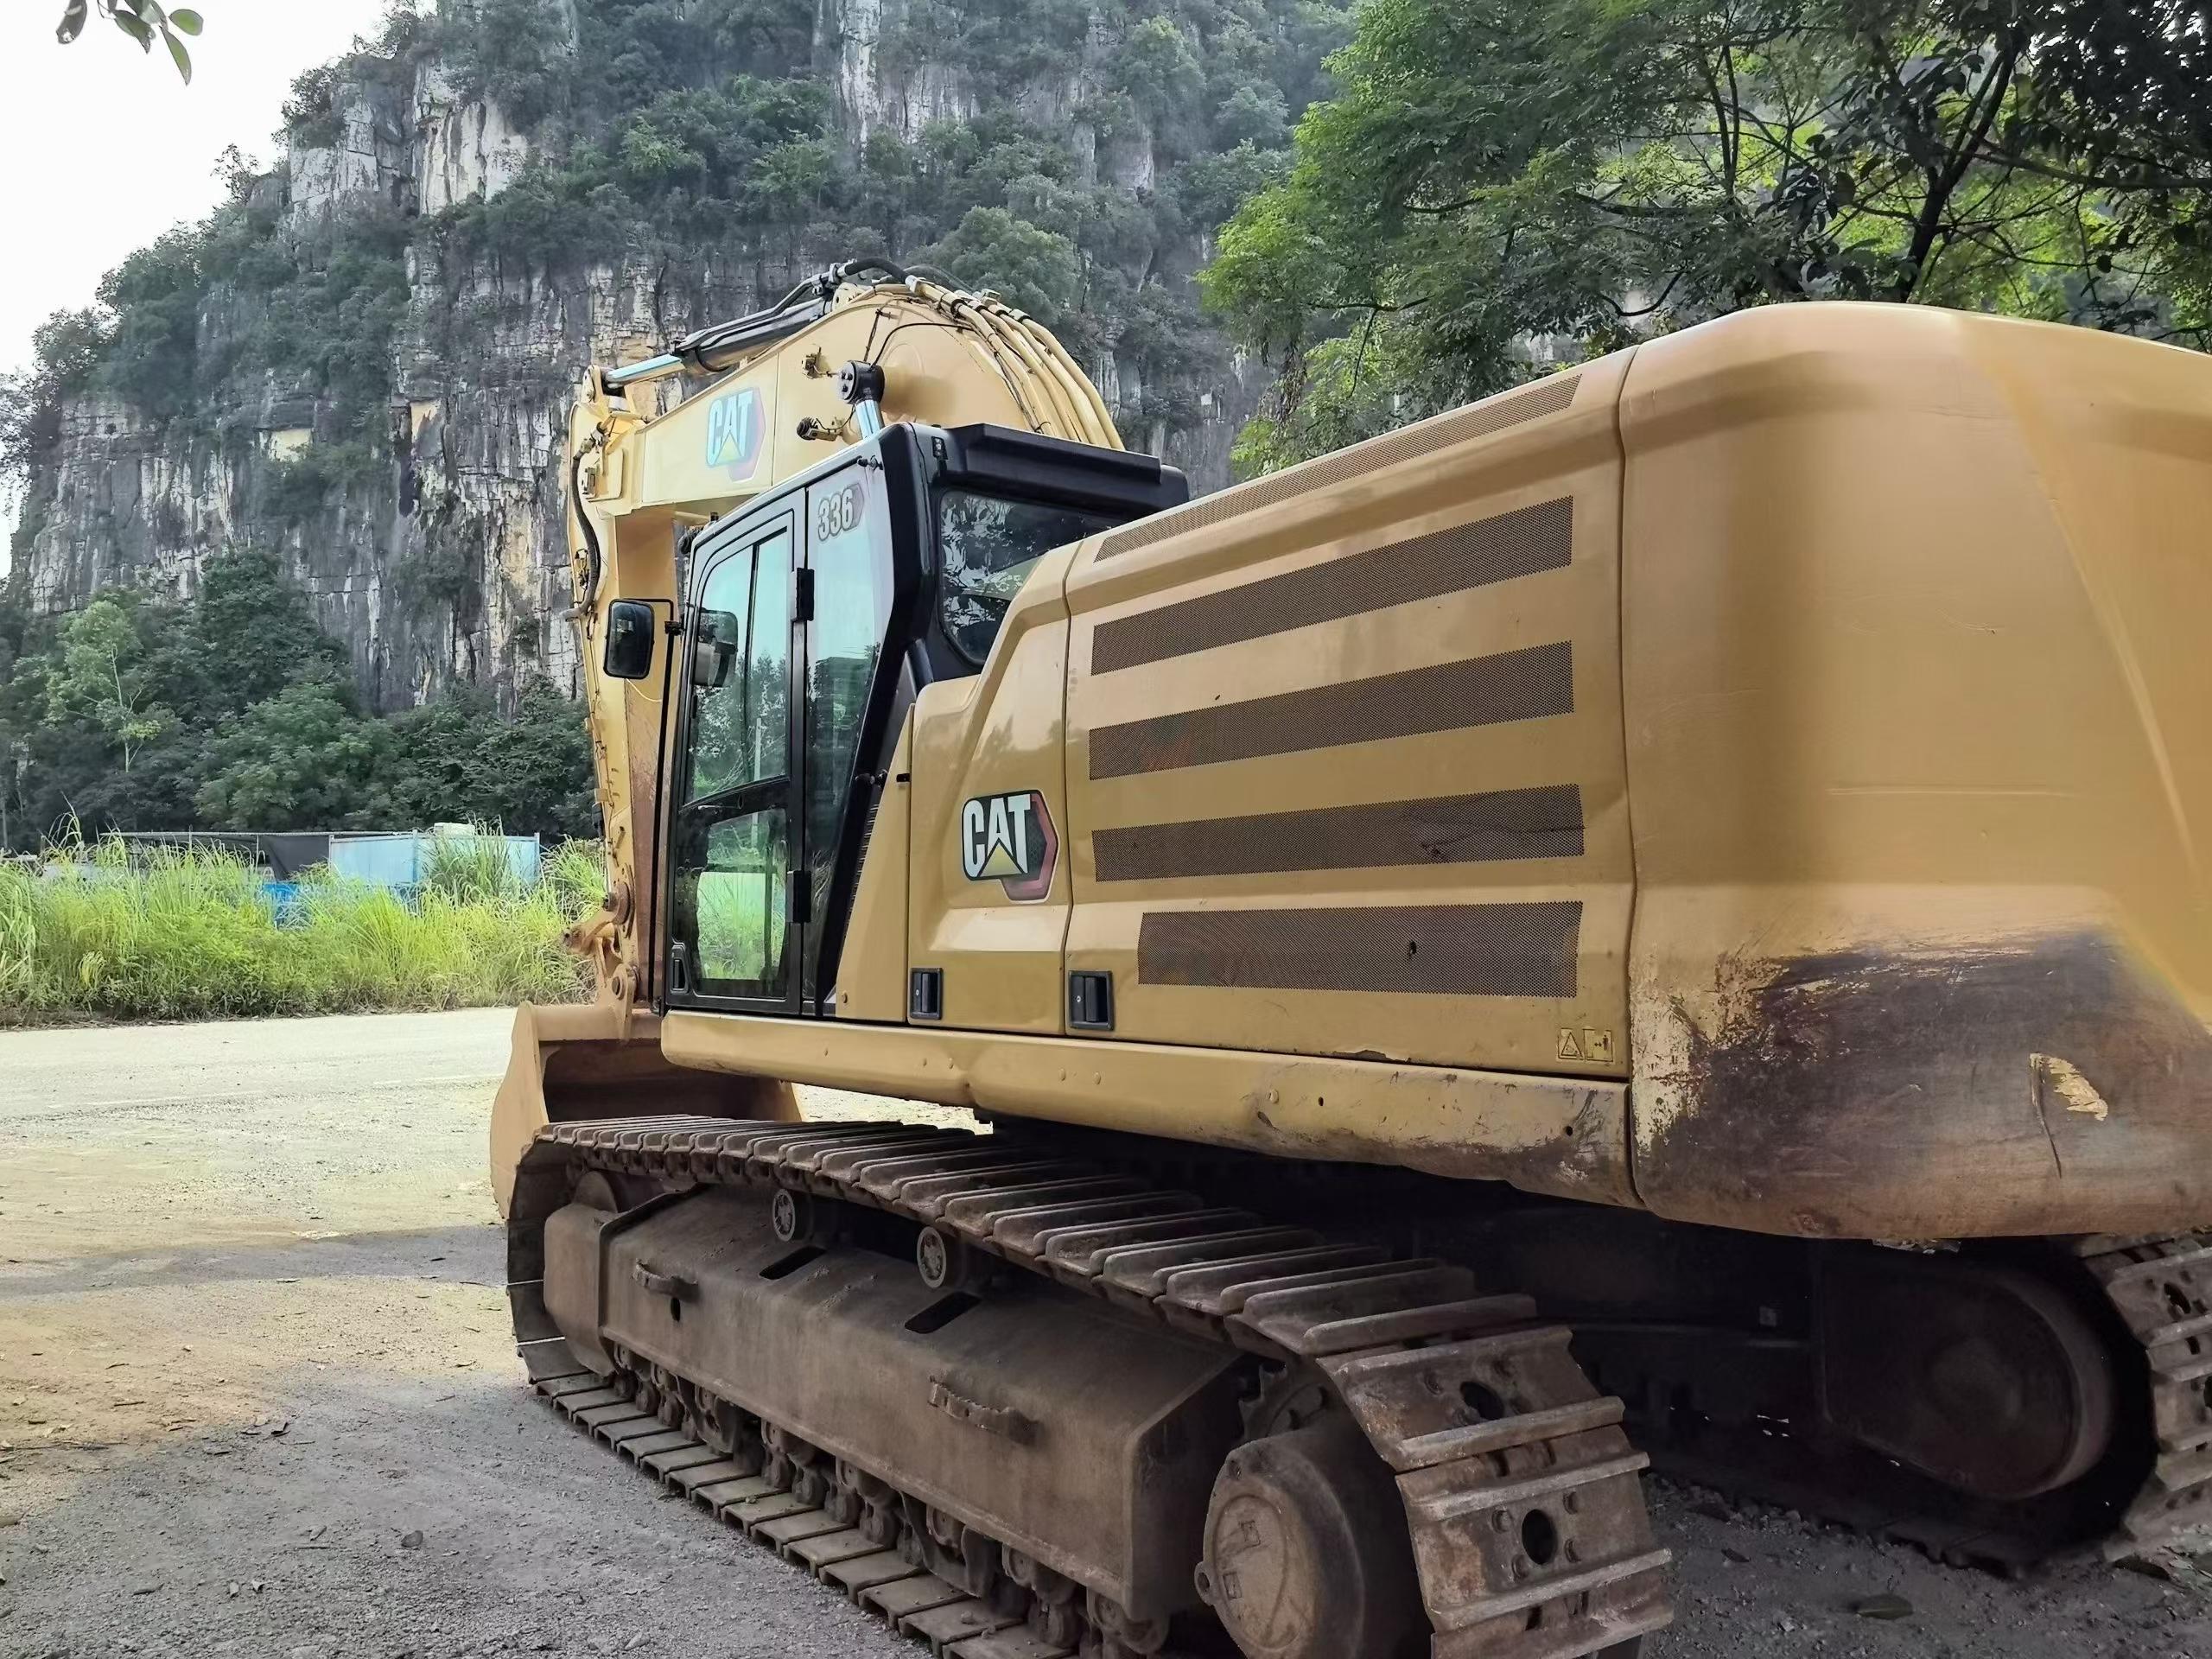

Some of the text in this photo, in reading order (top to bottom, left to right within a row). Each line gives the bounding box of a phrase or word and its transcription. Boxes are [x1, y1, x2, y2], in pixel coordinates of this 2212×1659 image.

[708, 390, 753, 466] CAT
[817, 487, 854, 541] 336
[963, 793, 1031, 878] CAT
